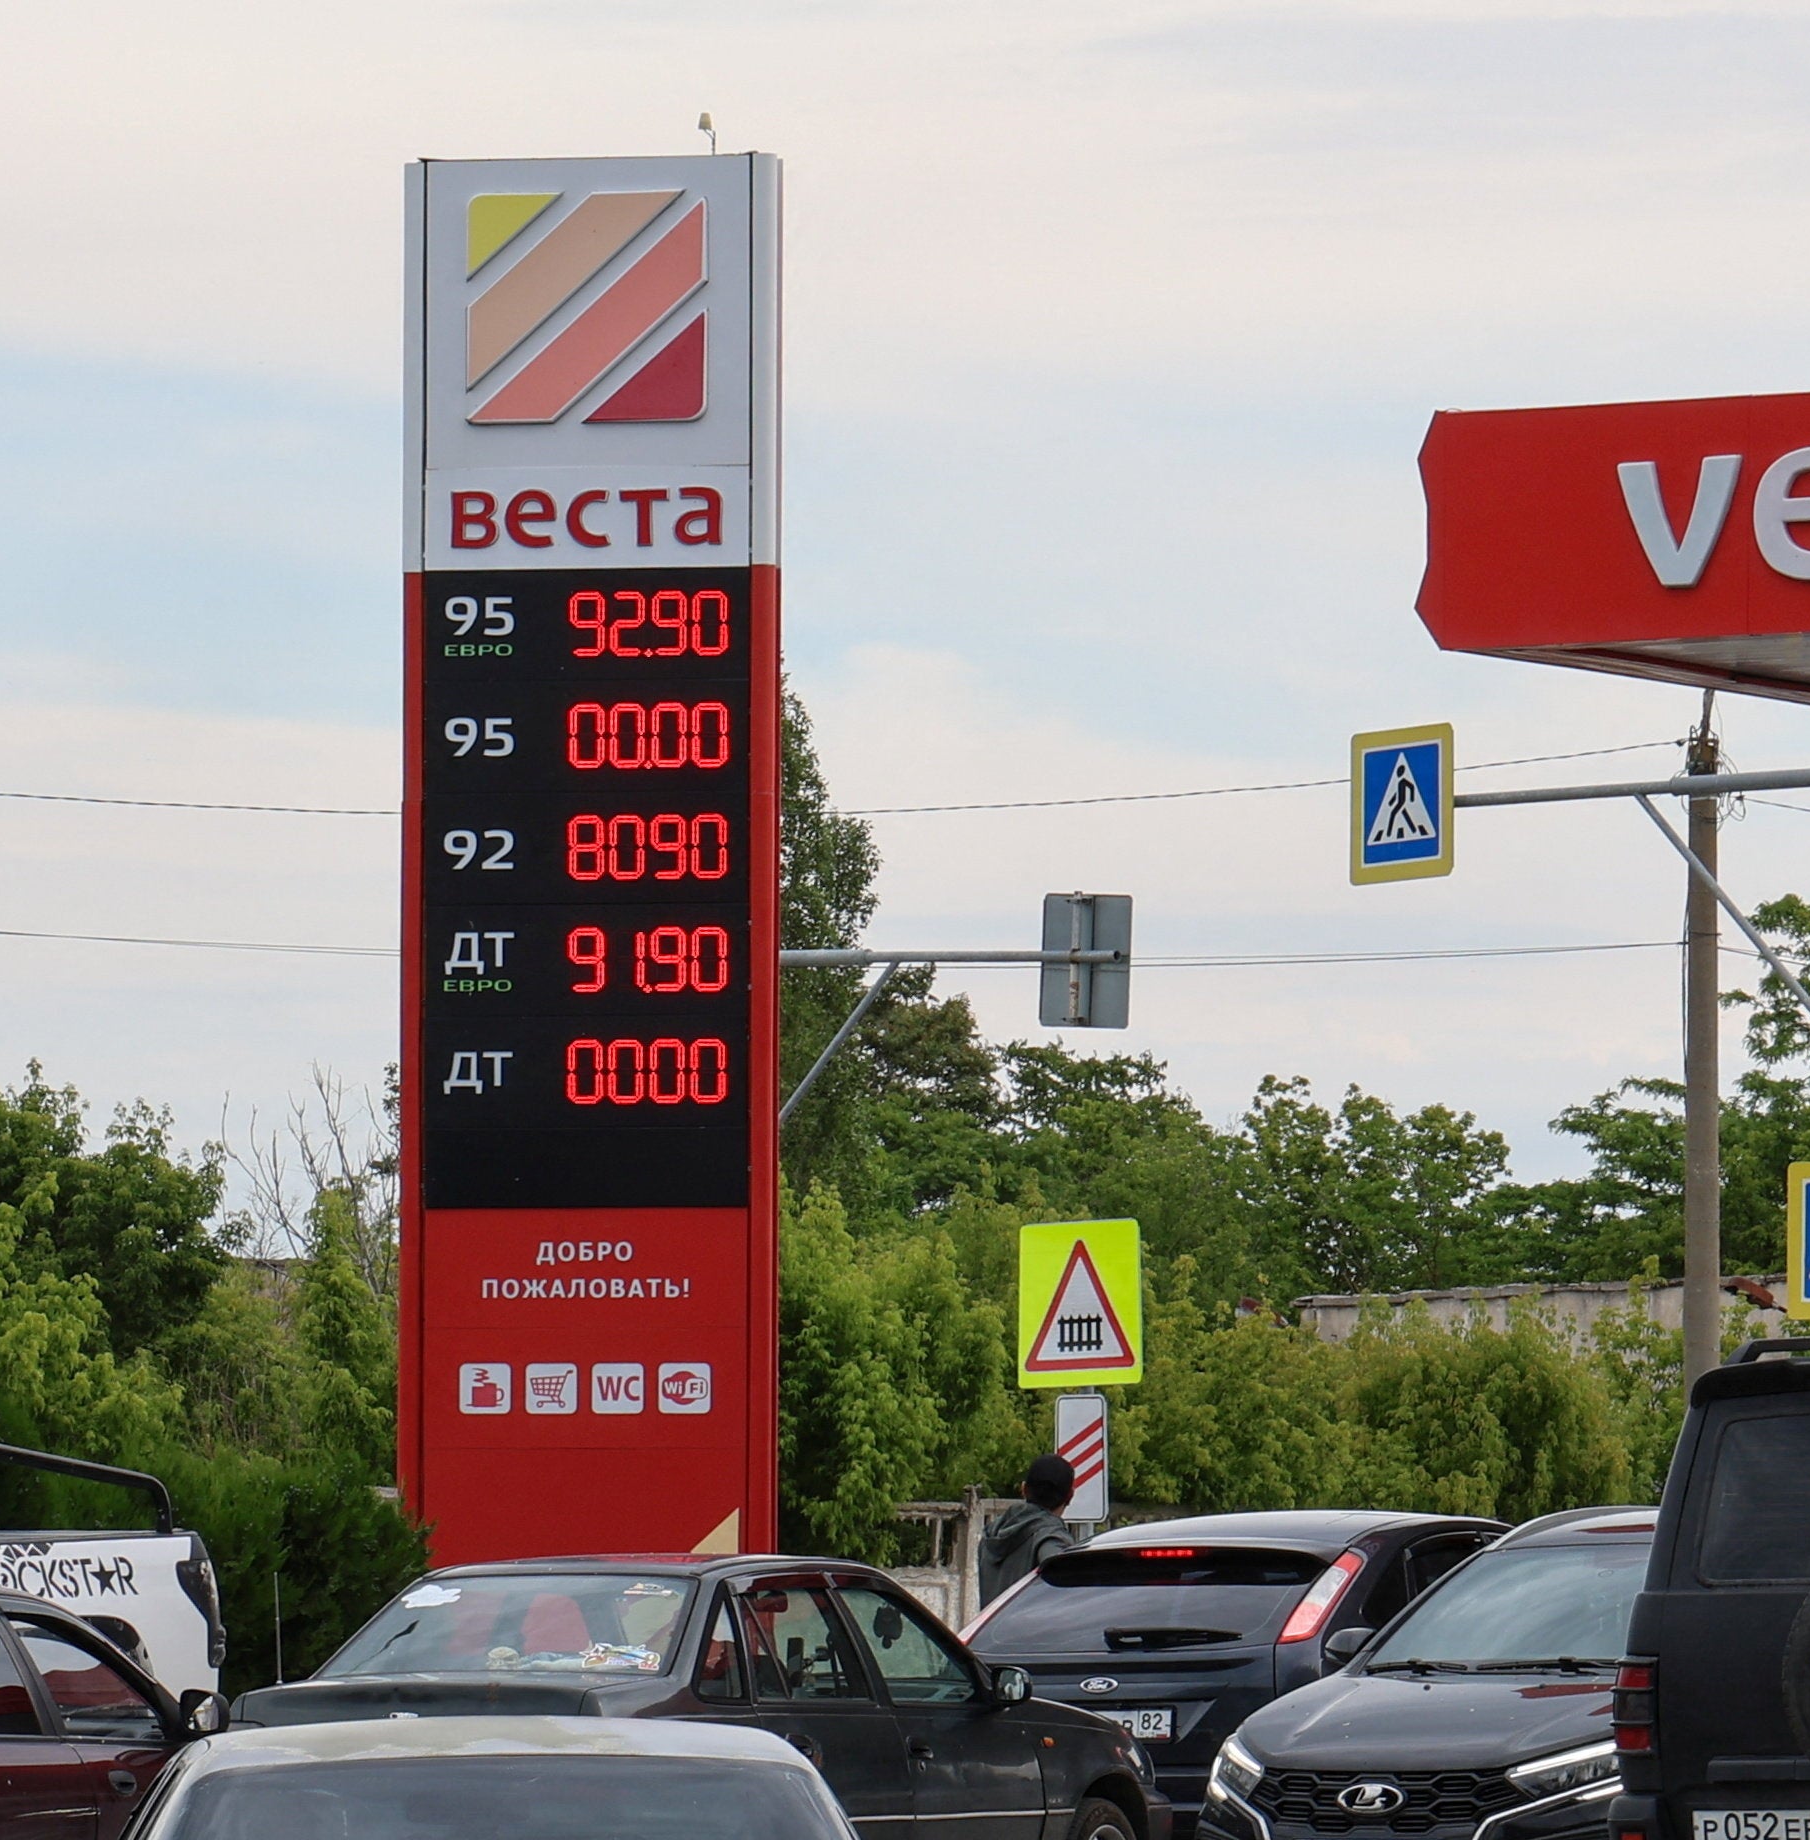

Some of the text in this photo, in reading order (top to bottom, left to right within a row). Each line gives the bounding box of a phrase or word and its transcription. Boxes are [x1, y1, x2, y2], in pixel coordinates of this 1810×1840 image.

[451, 486, 723, 549] веста
[444, 596, 516, 636] 95
[444, 643, 513, 657] ЕВРО
[444, 717, 516, 757] 95
[443, 829, 515, 870] 92
[444, 931, 515, 975] ДТ
[443, 979, 512, 993] ЕВРО
[443, 1051, 513, 1095] ДТ
[536, 1241, 634, 1266] ДОБРО
[482, 1277, 690, 1300] ПОЖАЛОВАТЬ!
[597, 1375, 641, 1402] WC
[1141, 1713, 1163, 1730] 82
